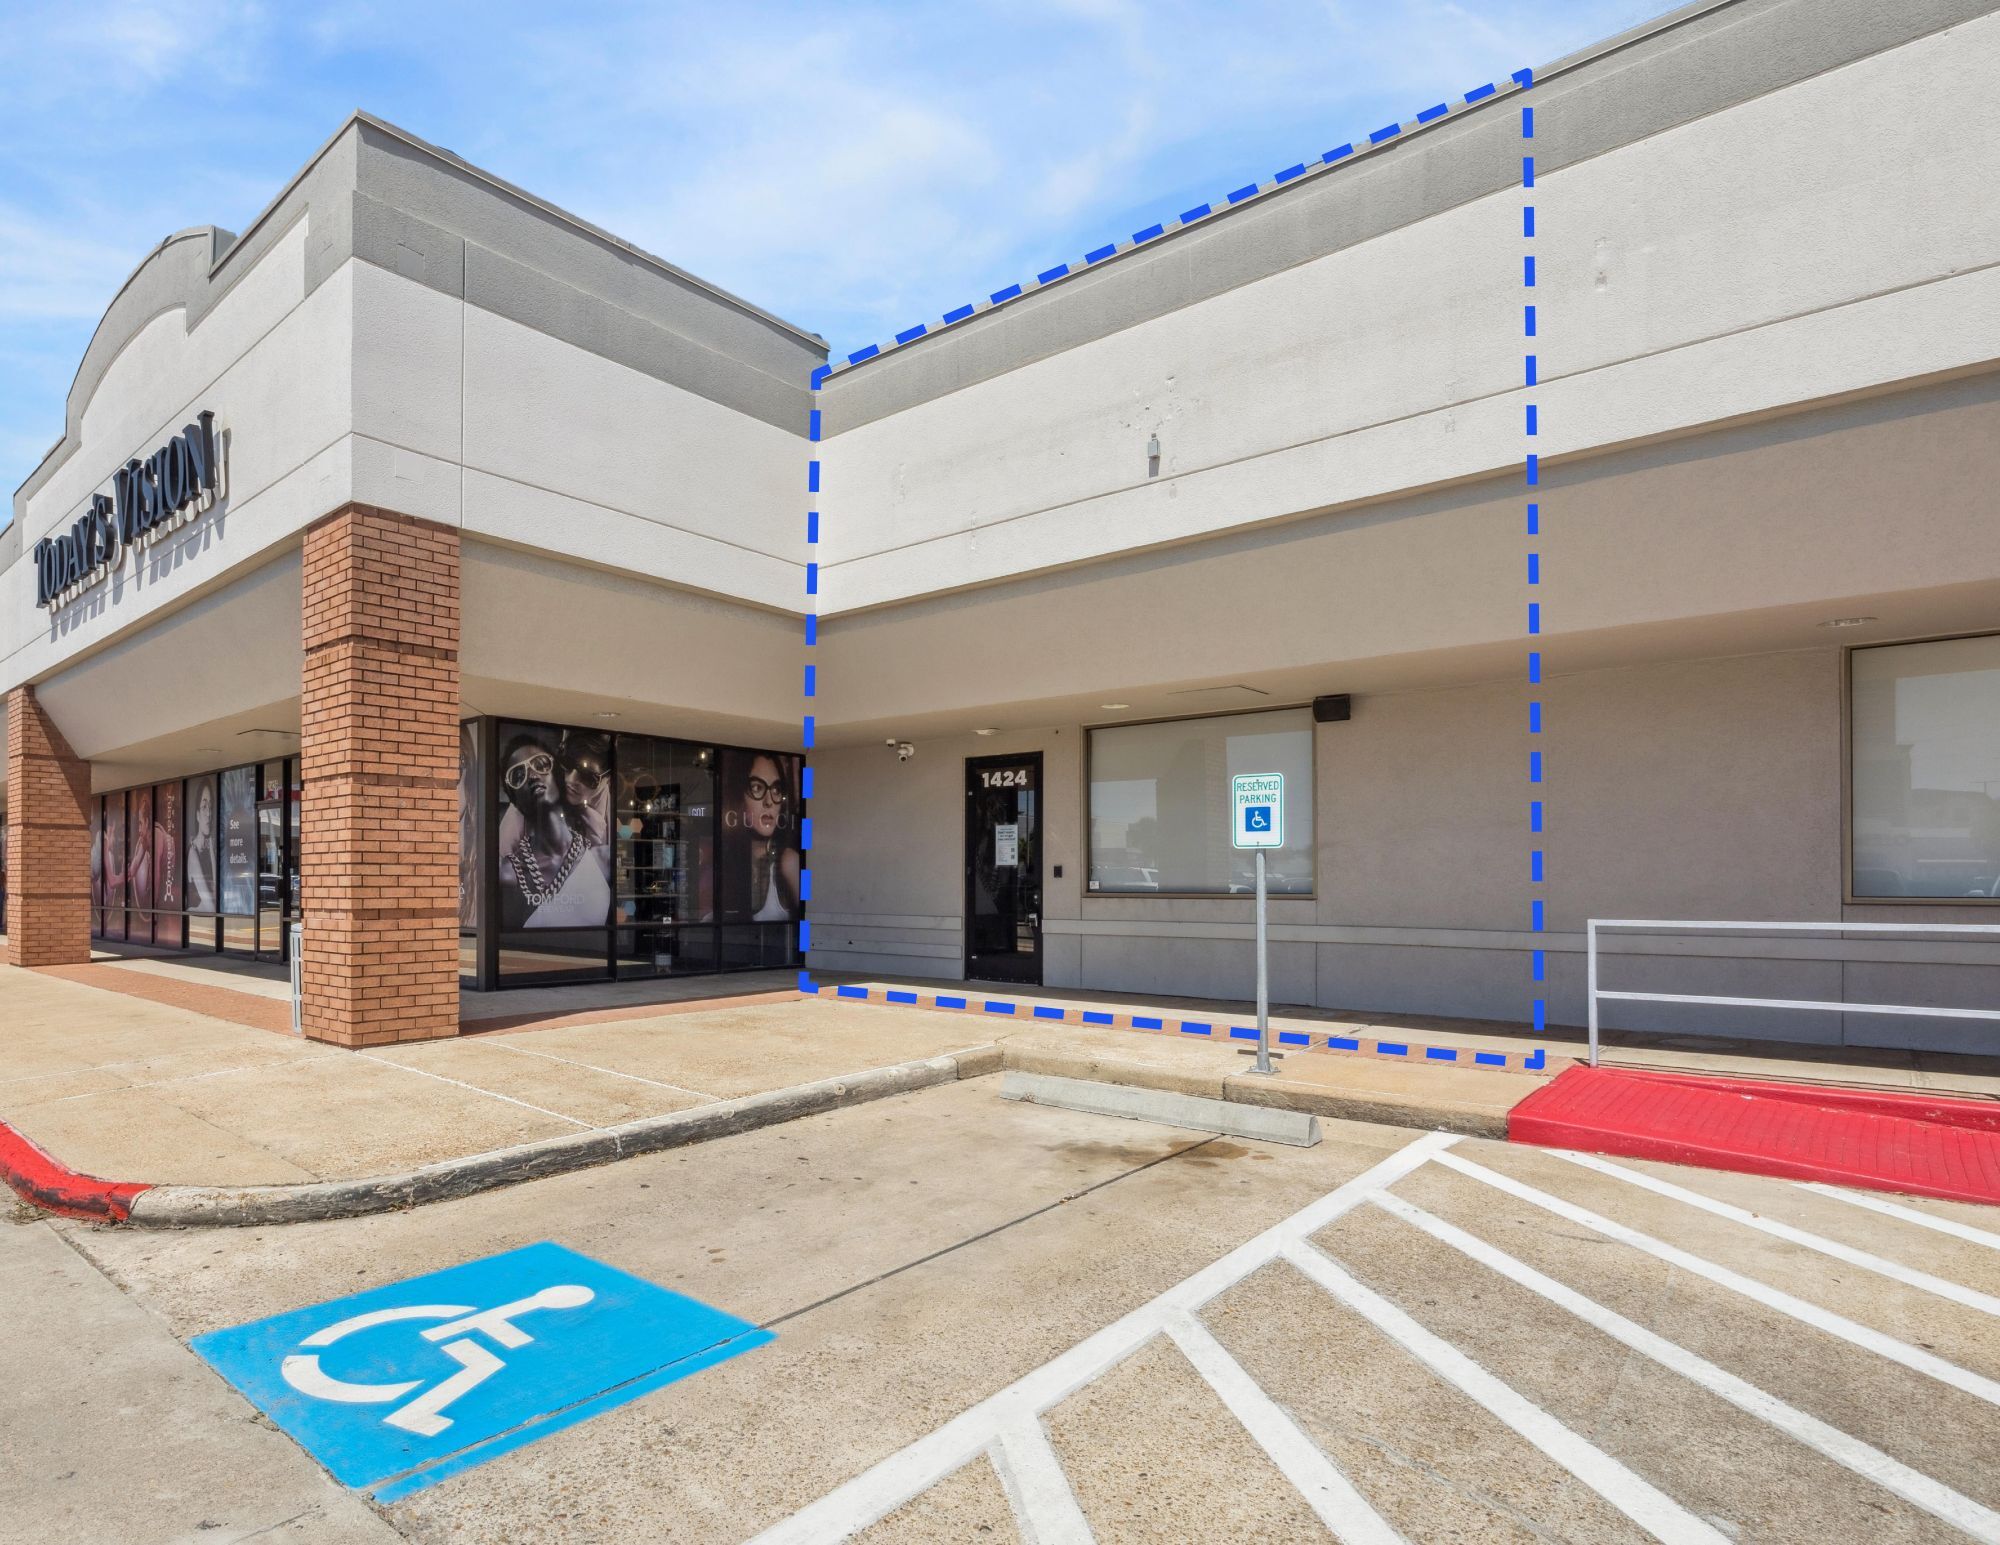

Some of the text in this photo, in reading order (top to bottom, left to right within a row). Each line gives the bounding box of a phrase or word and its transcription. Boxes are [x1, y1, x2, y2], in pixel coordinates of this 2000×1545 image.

[34, 410, 216, 609] TODAY'S VISION
[982, 770, 1027, 788] 1424
[1236, 781, 1279, 792] RESERVED
[1239, 794, 1277, 804] PARKING
[229, 820, 240, 830] See
[725, 810, 796, 831] GUCCI
[229, 838, 244, 847] more
[525, 893, 585, 905] TOM FORD
